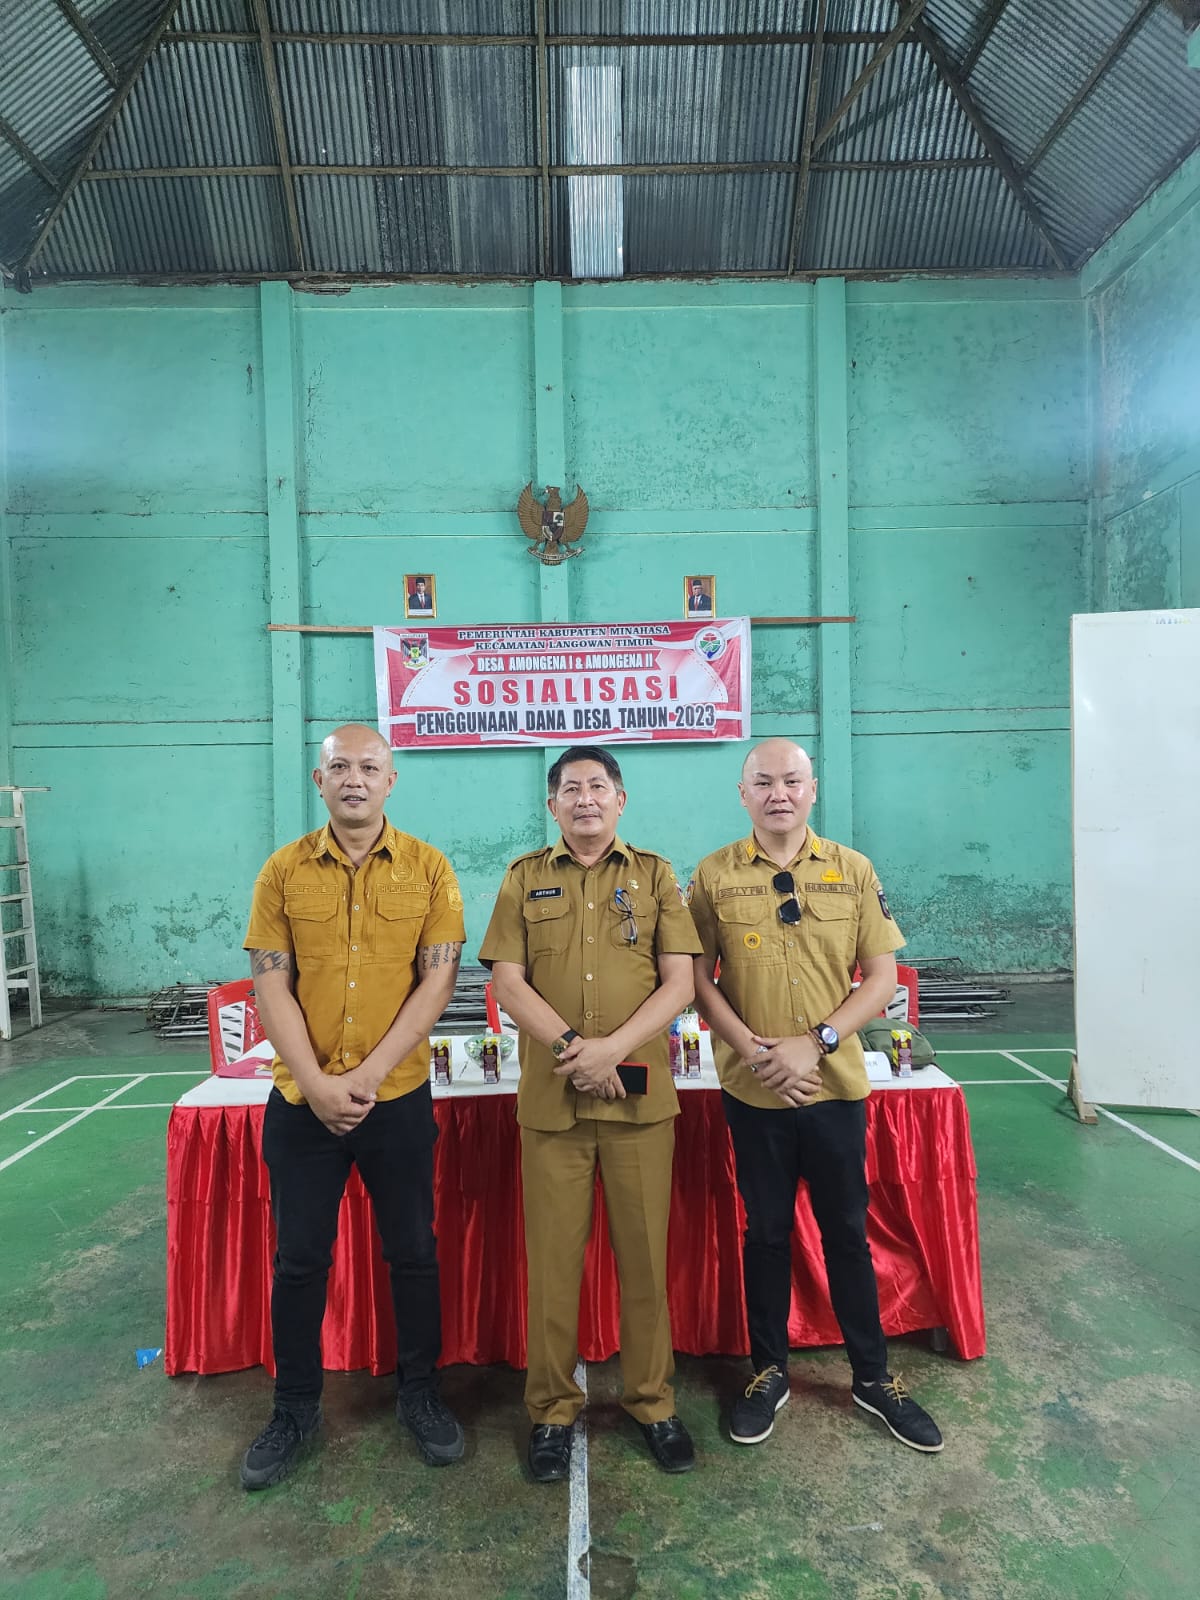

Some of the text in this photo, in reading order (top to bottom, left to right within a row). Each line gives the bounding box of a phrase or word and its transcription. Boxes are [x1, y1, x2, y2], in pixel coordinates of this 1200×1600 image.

[458, 626, 670, 640] PEMERINTAH KABUPATEN MINAHASA
[476, 638, 654, 650] KECAMATAN LANGOWAN TIMUR
[477, 653, 653, 672] DESA AMONGENA I & AMONGENA II
[453, 675, 678, 706] SOSIALISASI
[417, 705, 716, 734] PENGGUNAAN DANA DESA TAHUN 2023
